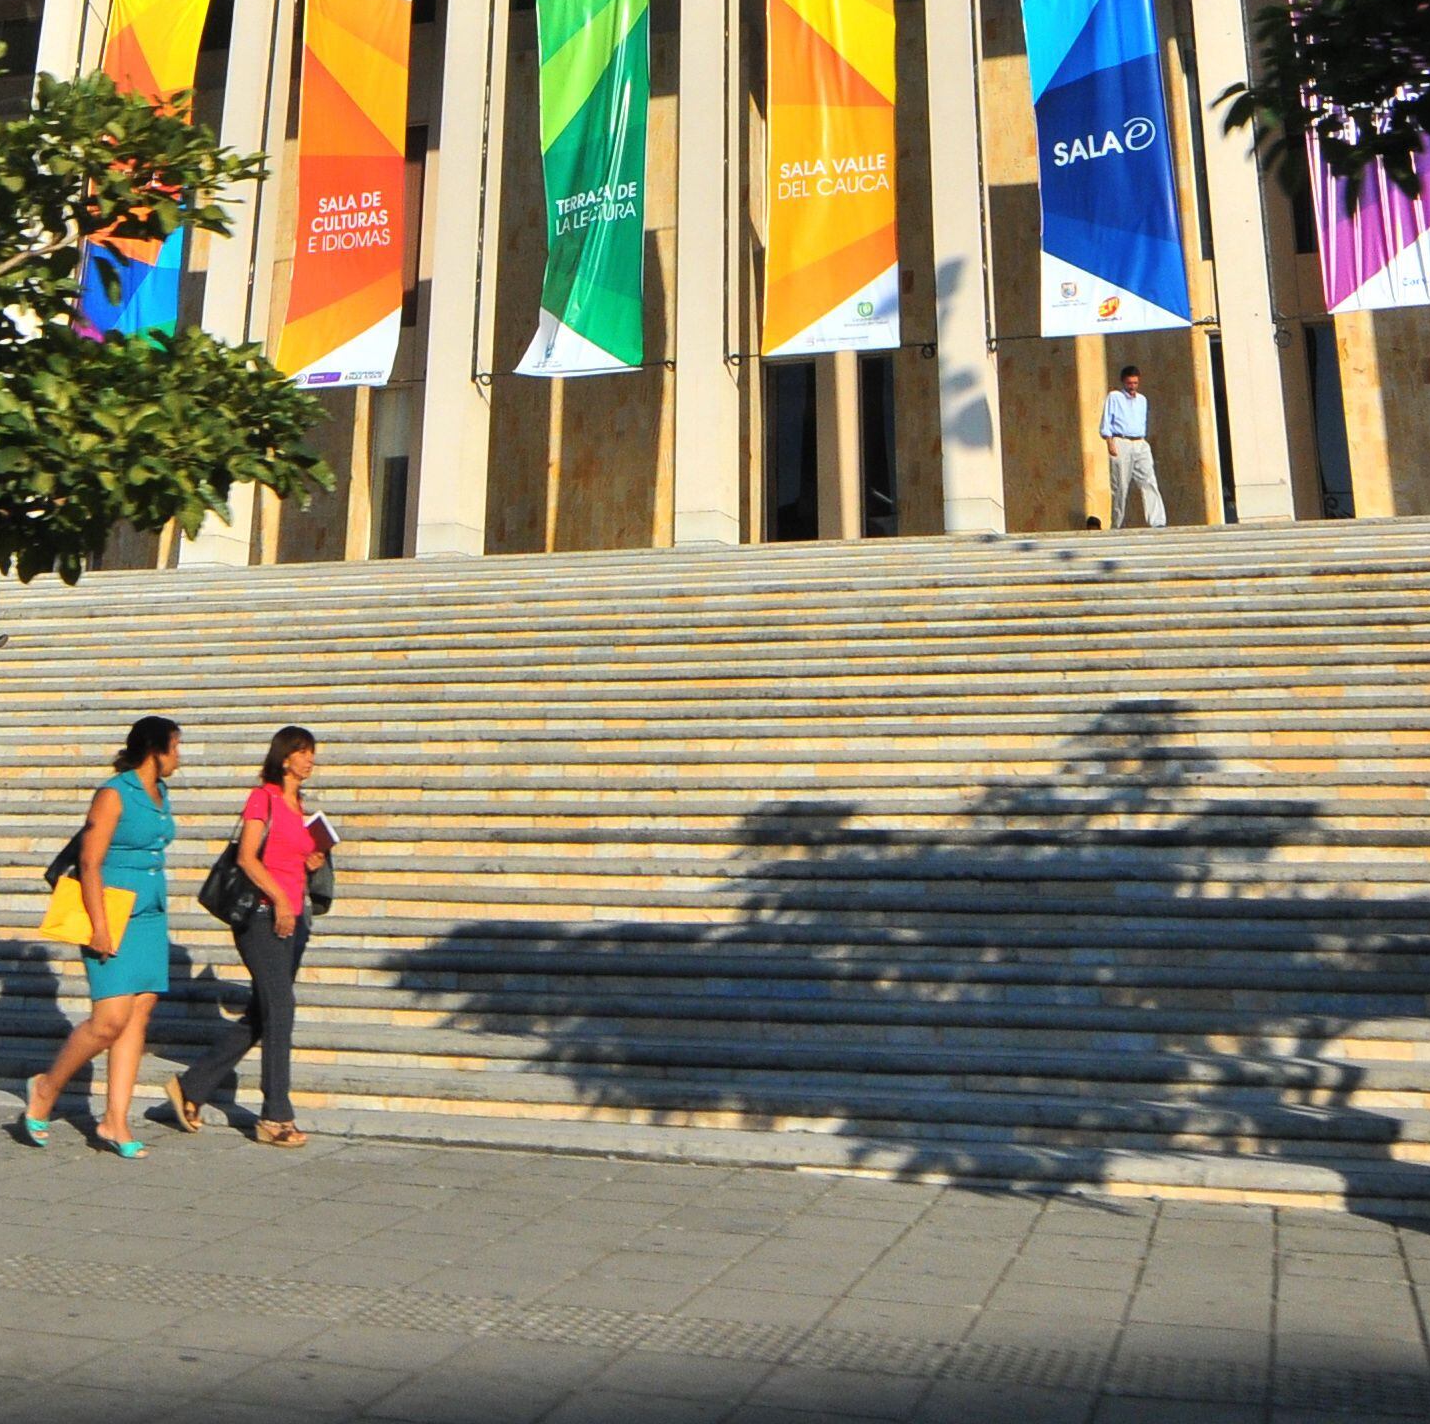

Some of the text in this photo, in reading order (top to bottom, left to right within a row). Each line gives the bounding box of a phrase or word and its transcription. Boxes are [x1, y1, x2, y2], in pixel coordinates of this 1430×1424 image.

[1053, 130, 1125, 167] SALA
[779, 153, 887, 180] SALA VALLE
[554, 181, 638, 216] TERRAZA DE
[778, 173, 890, 200] DEL CAUCA
[318, 191, 382, 214] SALA DE
[311, 209, 389, 233] CULTURAS
[555, 200, 637, 236] LA LECTURA
[308, 228, 391, 253] E IDIOMAS
